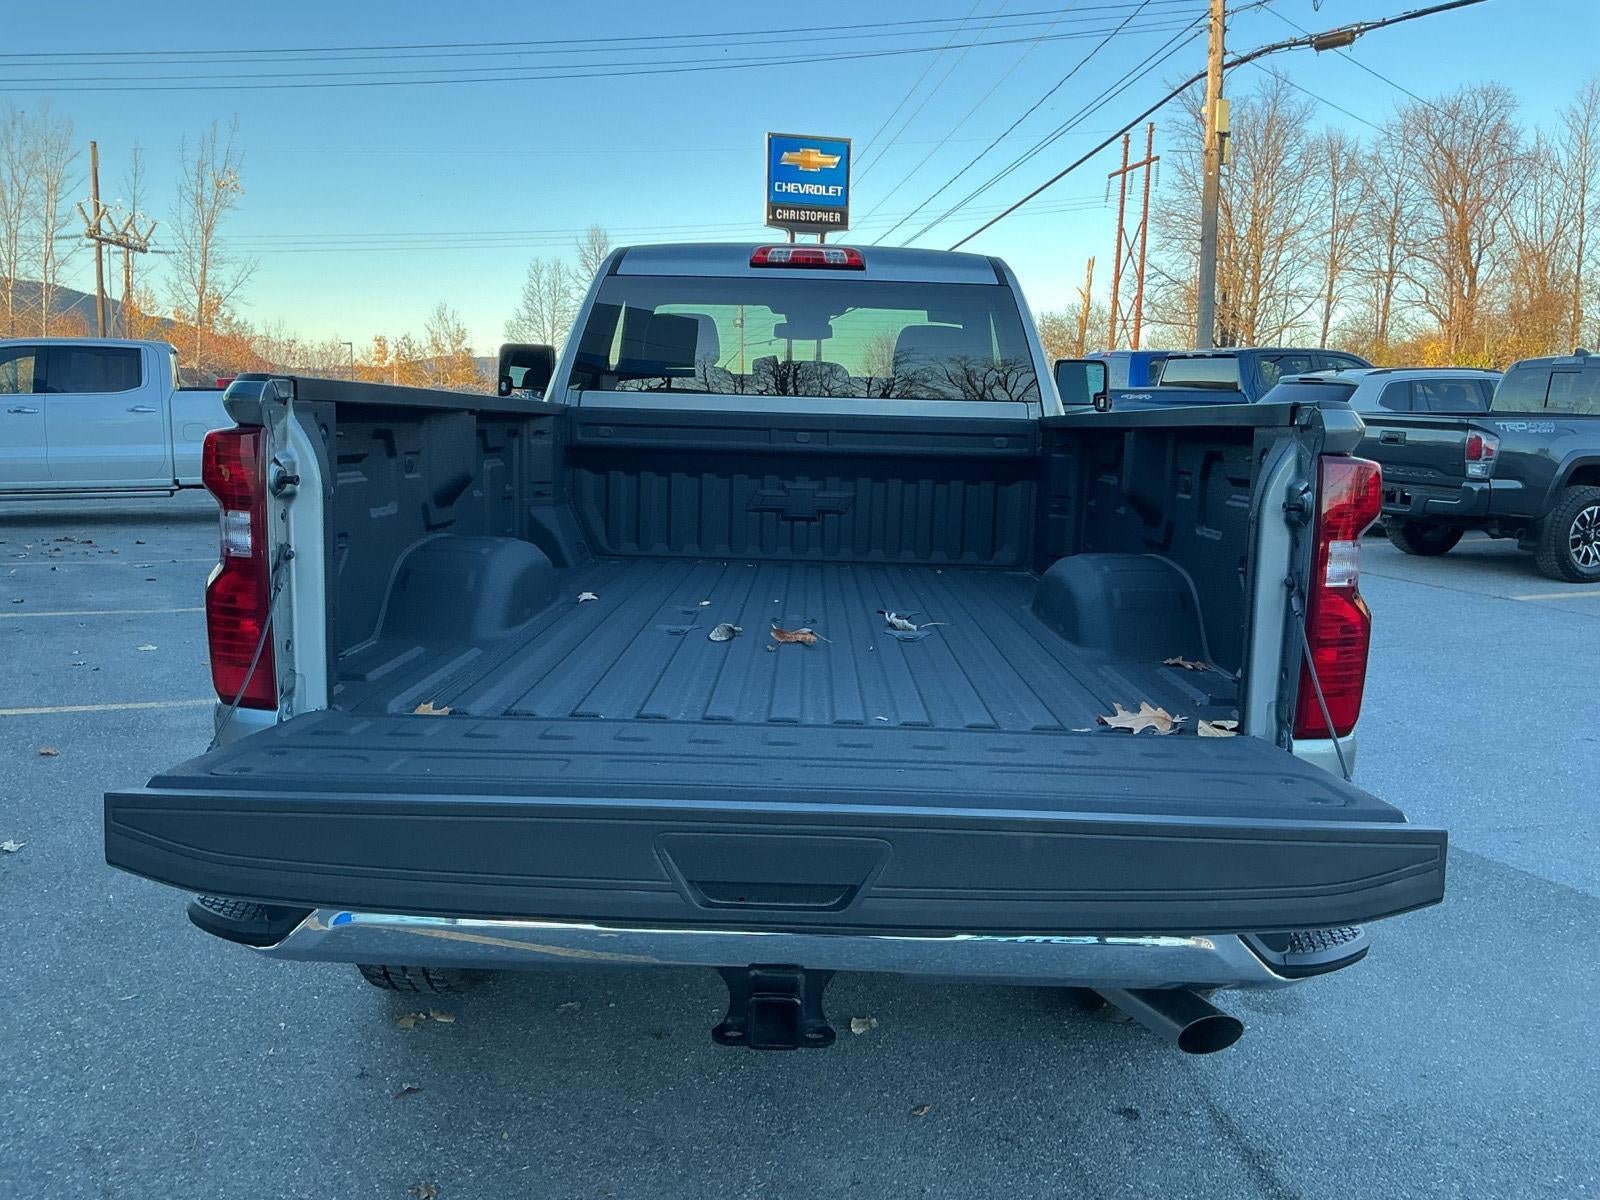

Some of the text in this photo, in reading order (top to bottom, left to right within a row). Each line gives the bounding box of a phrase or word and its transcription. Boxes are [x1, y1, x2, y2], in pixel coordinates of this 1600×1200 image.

[774, 182, 843, 196] CHEVROLET
[776, 208, 841, 222] CHRISTOPHER
[1494, 421, 1527, 433] TRD
